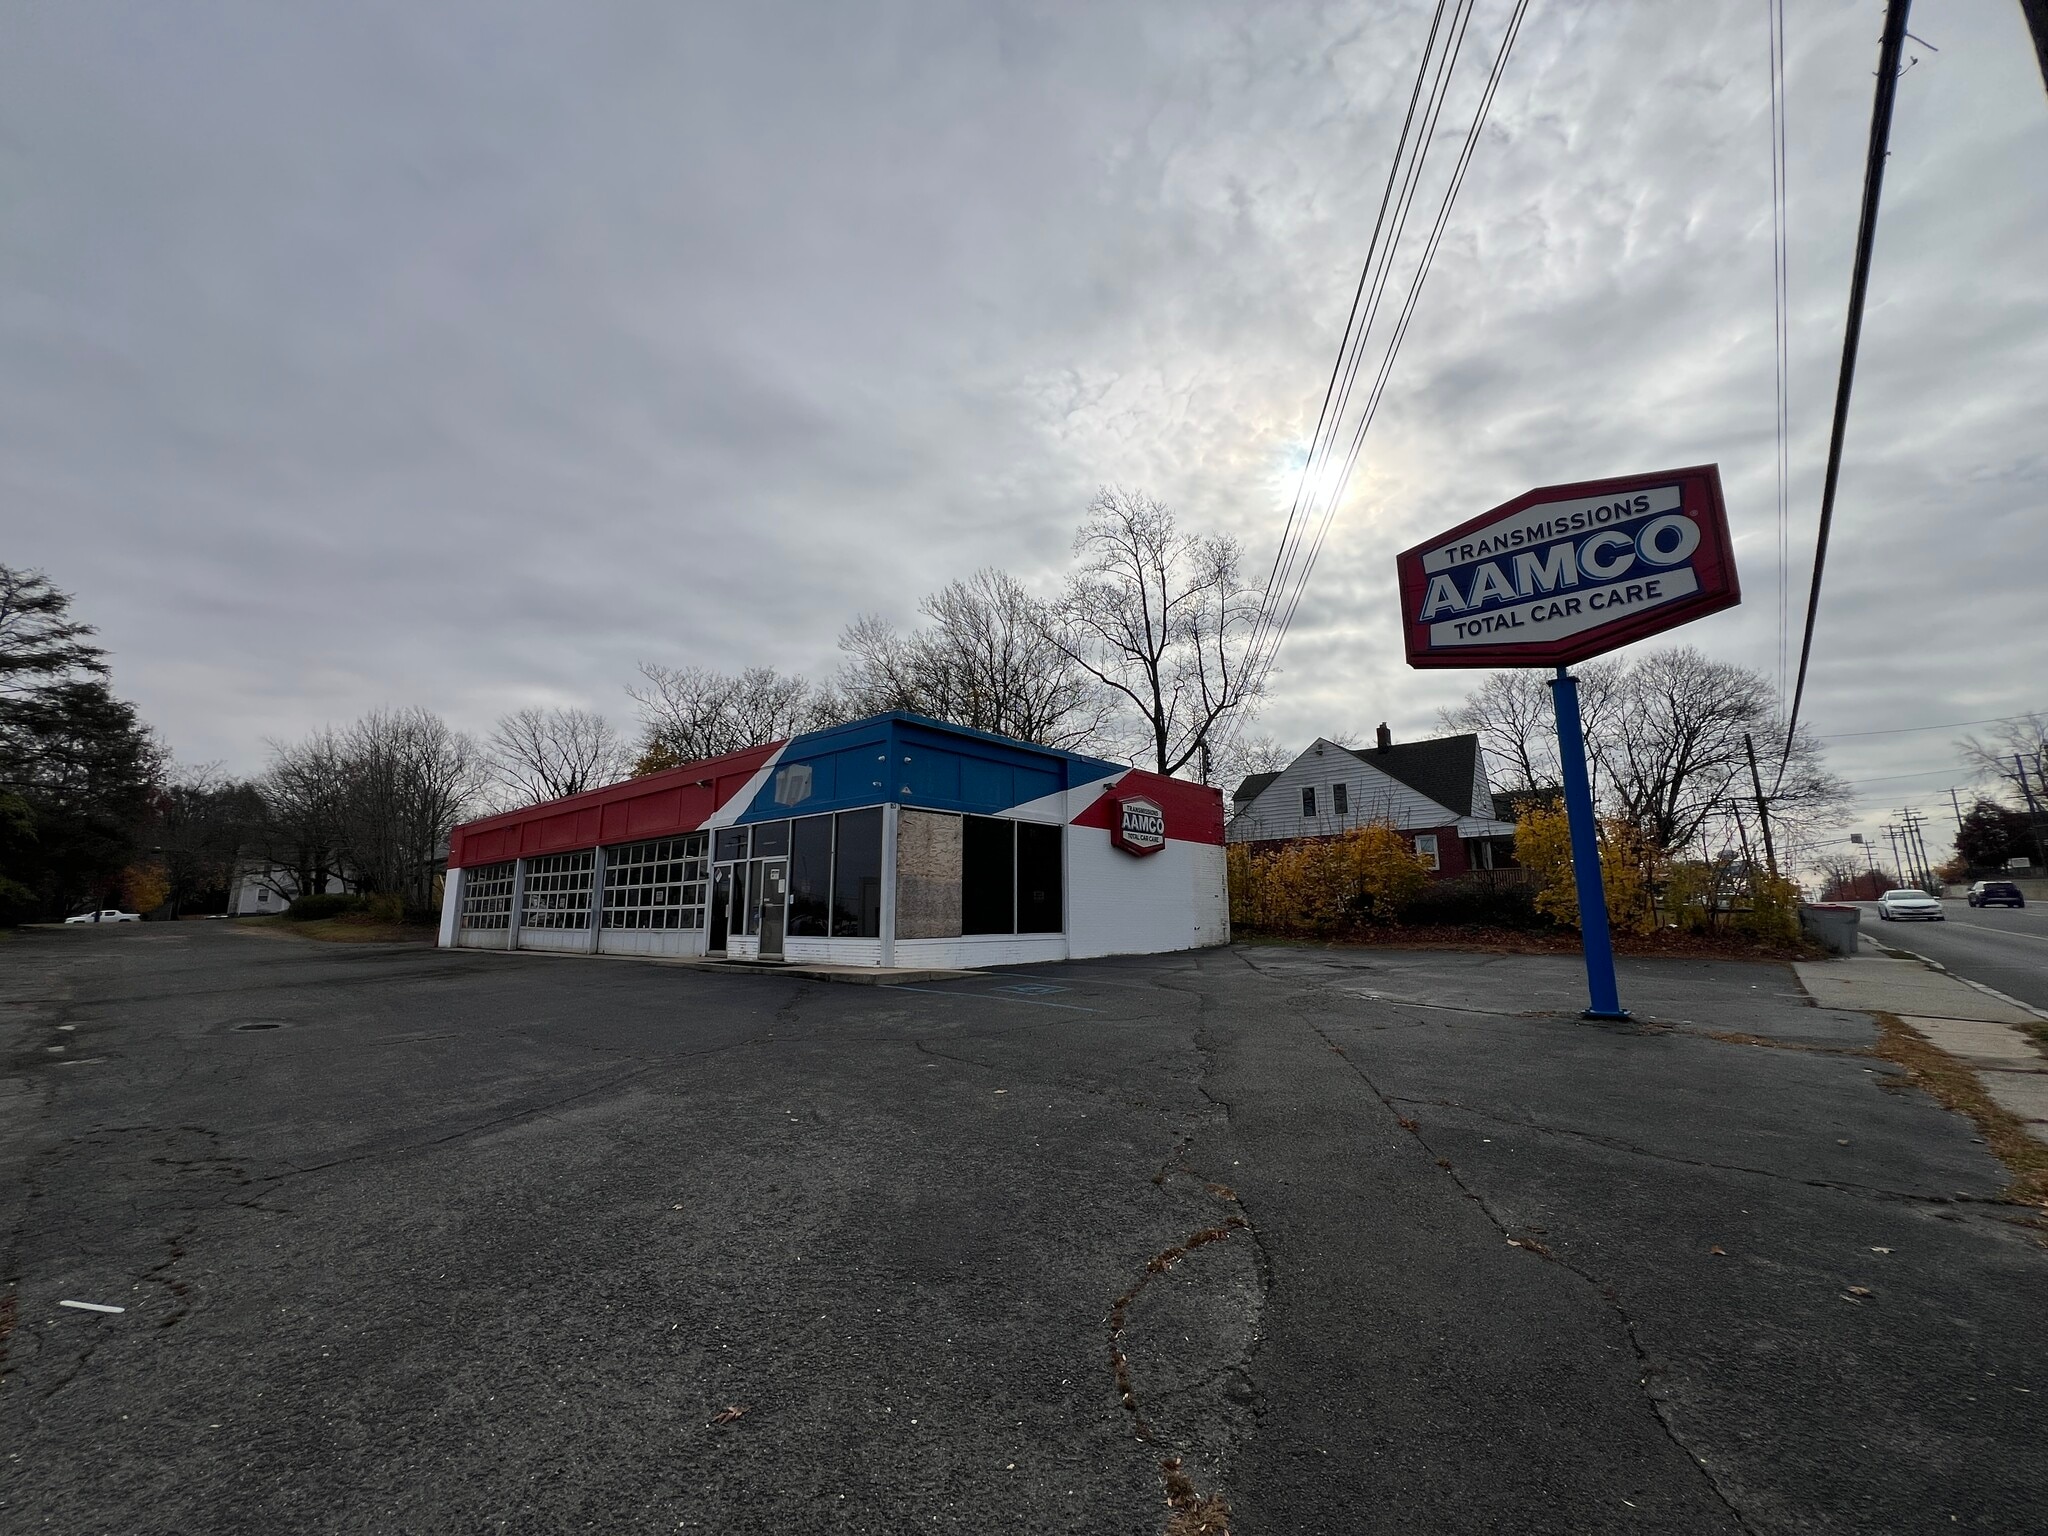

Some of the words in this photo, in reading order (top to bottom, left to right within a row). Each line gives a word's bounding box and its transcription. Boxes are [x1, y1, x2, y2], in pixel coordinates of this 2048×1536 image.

[1445, 495, 1650, 563] TRANSMISSIONS
[1419, 514, 1701, 621] AAMCO
[1454, 613, 1525, 639] TOTAL
[1531, 598, 1582, 621] CAR
[1589, 580, 1662, 610] CARE
[1122, 813, 1164, 834] AAMCO
